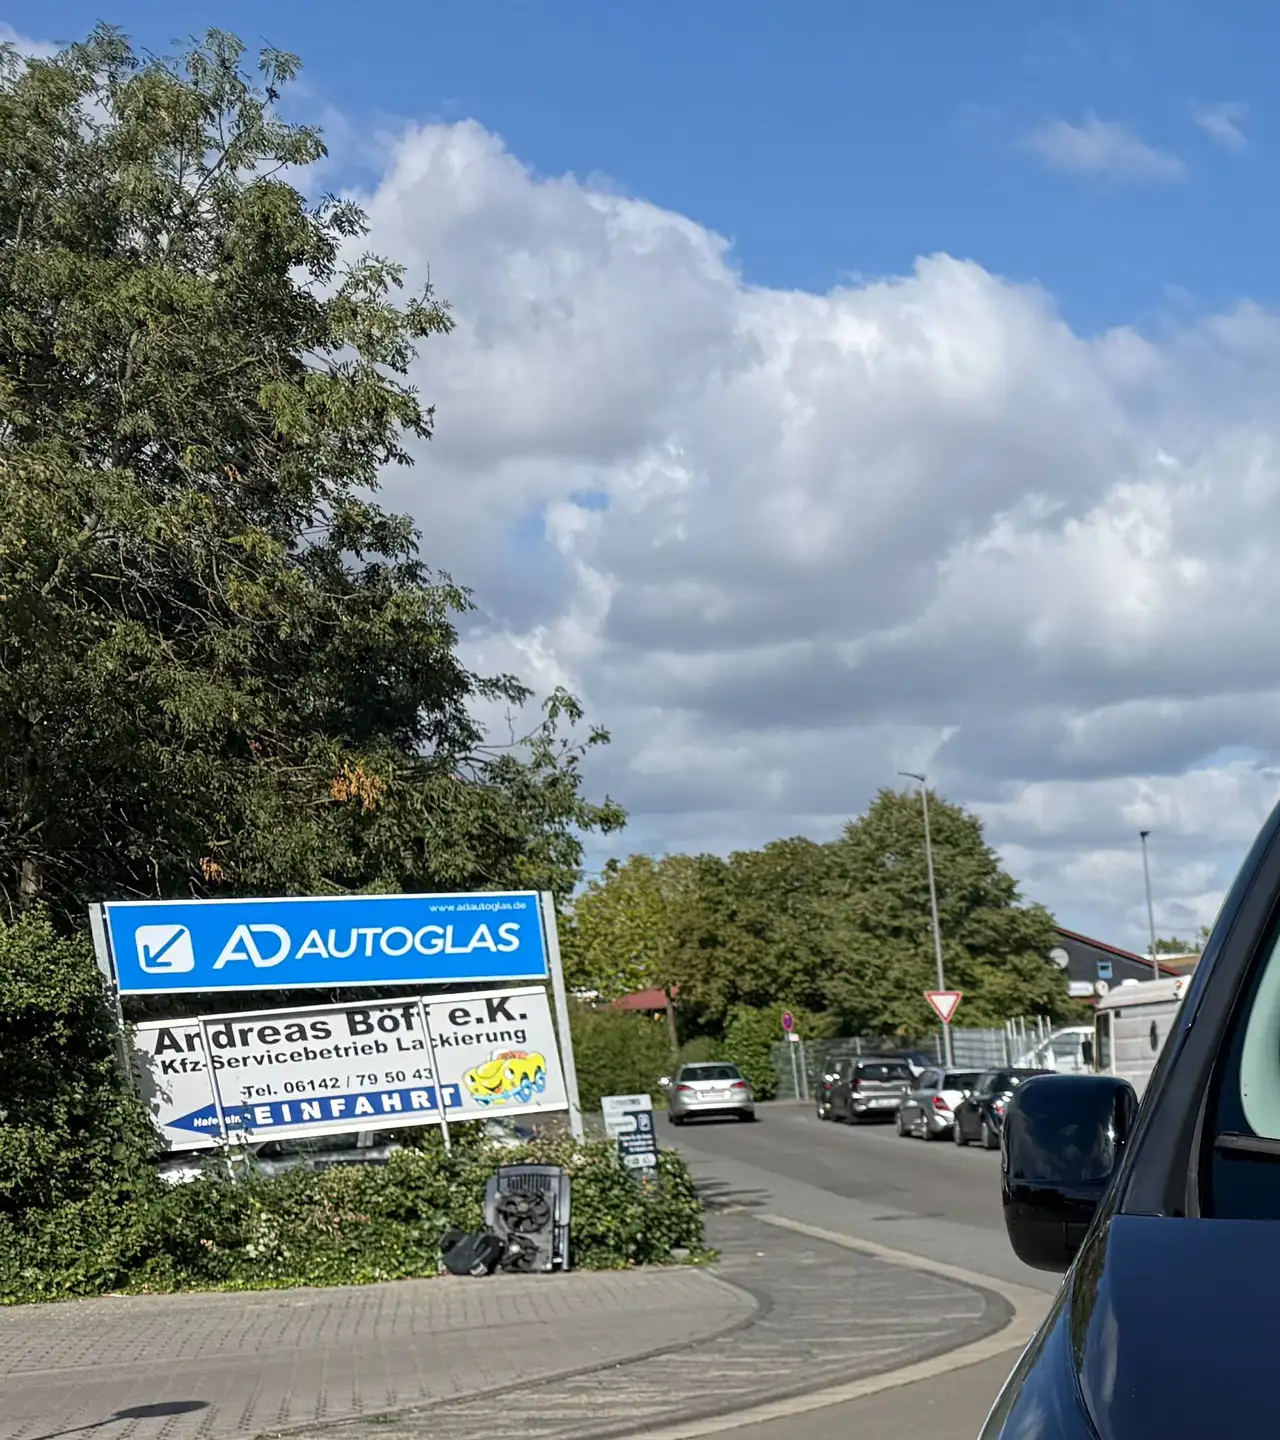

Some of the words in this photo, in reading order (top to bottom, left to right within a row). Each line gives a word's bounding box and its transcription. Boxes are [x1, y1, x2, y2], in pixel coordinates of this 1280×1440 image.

[212, 924, 291, 969] AD
[295, 922, 521, 960] AUTOGLAS
[154, 1020, 332, 1055] Andreas
[449, 997, 528, 1026] e.K.
[161, 1039, 388, 1076] Kfz-Servicebetrieb
[397, 1028, 527, 1051] Lackierung
[244, 1085, 278, 1098] Tel.
[284, 1077, 341, 1093] 06142
[356, 1073, 378, 1086] 79
[385, 1070, 406, 1083] 50
[412, 1067, 434, 1081] 43
[193, 1114, 242, 1128] Hafestr.
[254, 1087, 455, 1126] EINFAHRT
